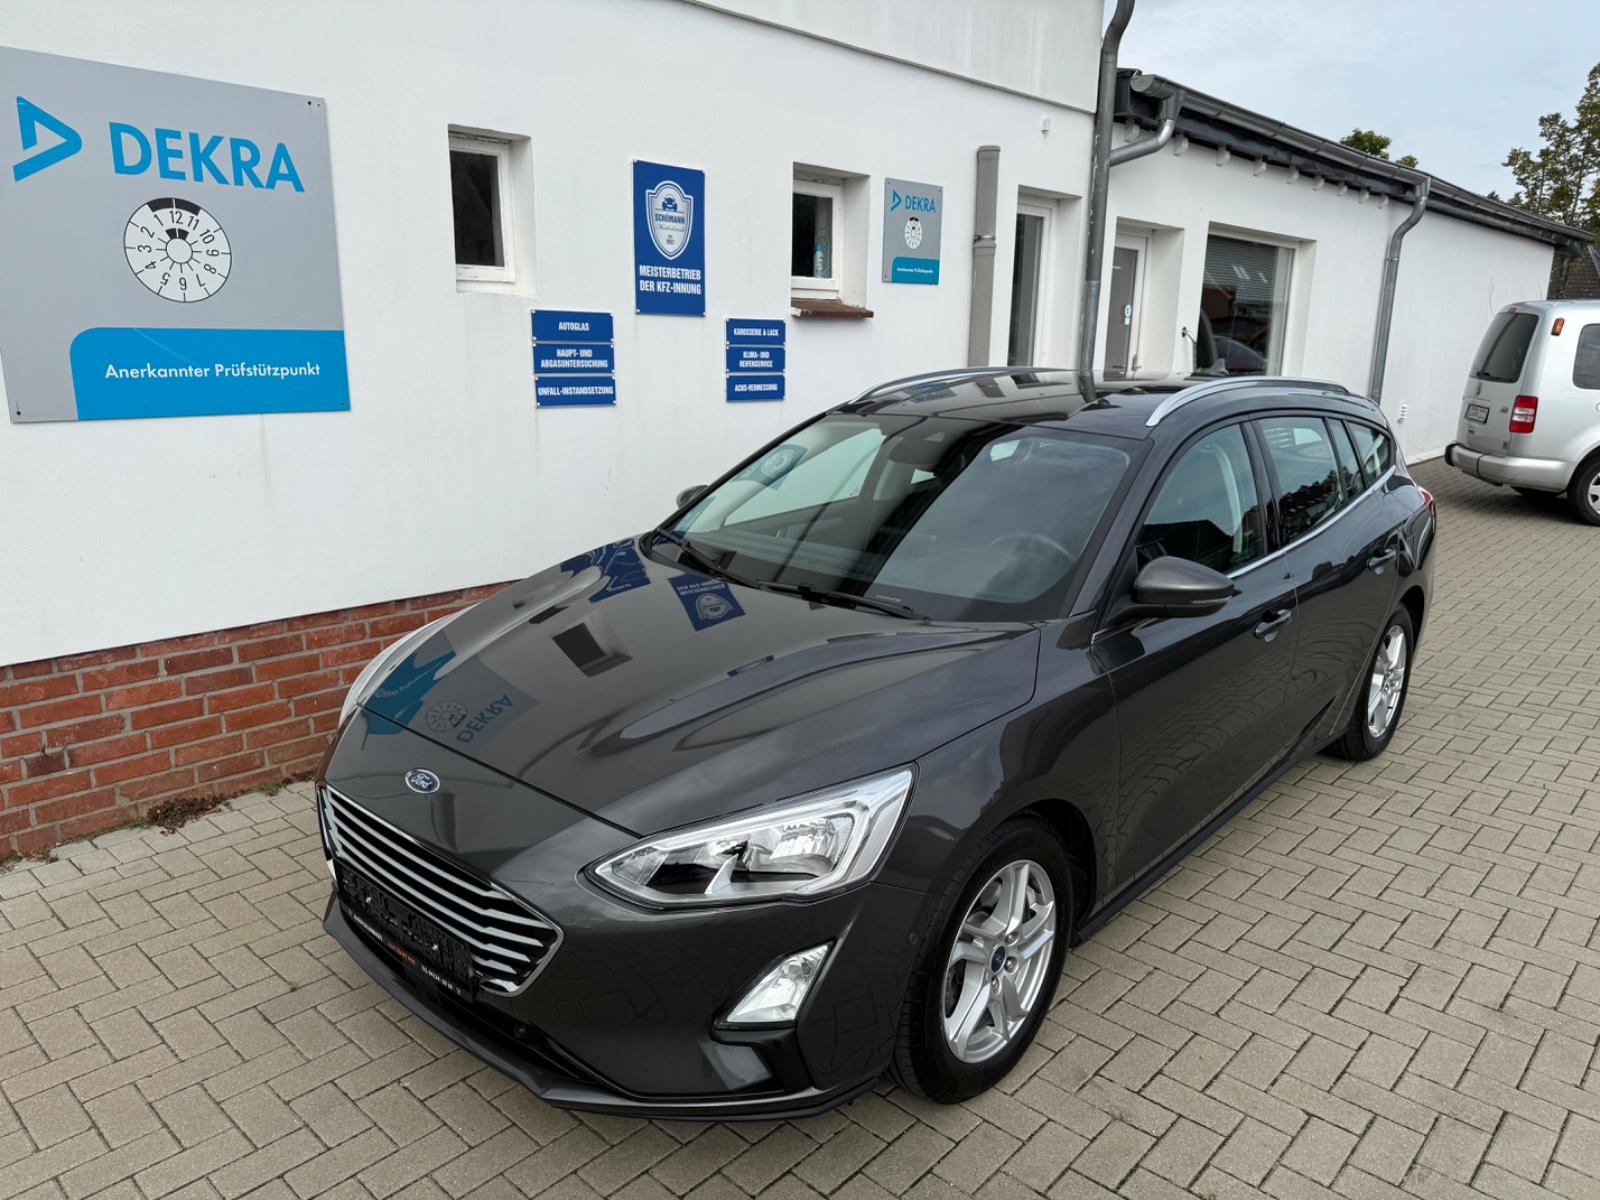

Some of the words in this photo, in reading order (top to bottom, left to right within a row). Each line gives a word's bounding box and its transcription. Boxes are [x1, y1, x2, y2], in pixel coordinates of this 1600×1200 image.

[108, 121, 305, 193] DEKRA
[904, 195, 936, 213] DEKRA
[153, 213, 164, 226] 1
[168, 210, 184, 225] 12
[187, 215, 200, 231] 11
[140, 226, 155, 239] 2
[199, 228, 215, 244] 10
[137, 244, 152, 253] 3
[205, 249, 220, 257] 9
[144, 260, 157, 270] 4
[203, 263, 217, 275] 8
[160, 272, 171, 286] 5
[639, 264, 701, 281] MEISTERBETRIEB
[178, 277, 188, 291] 6
[195, 273, 206, 287] 7
[639, 280, 656, 292] DER
[656, 281, 701, 295] KFZ-INNUNG
[558, 321, 590, 331] AUTOGLAS
[767, 329, 779, 337] LACK
[556, 348, 579, 358] HAUPT-
[579, 348, 593, 358] UND
[104, 362, 210, 379] Anerkannter
[214, 361, 320, 380] Prüfstützpunkt
